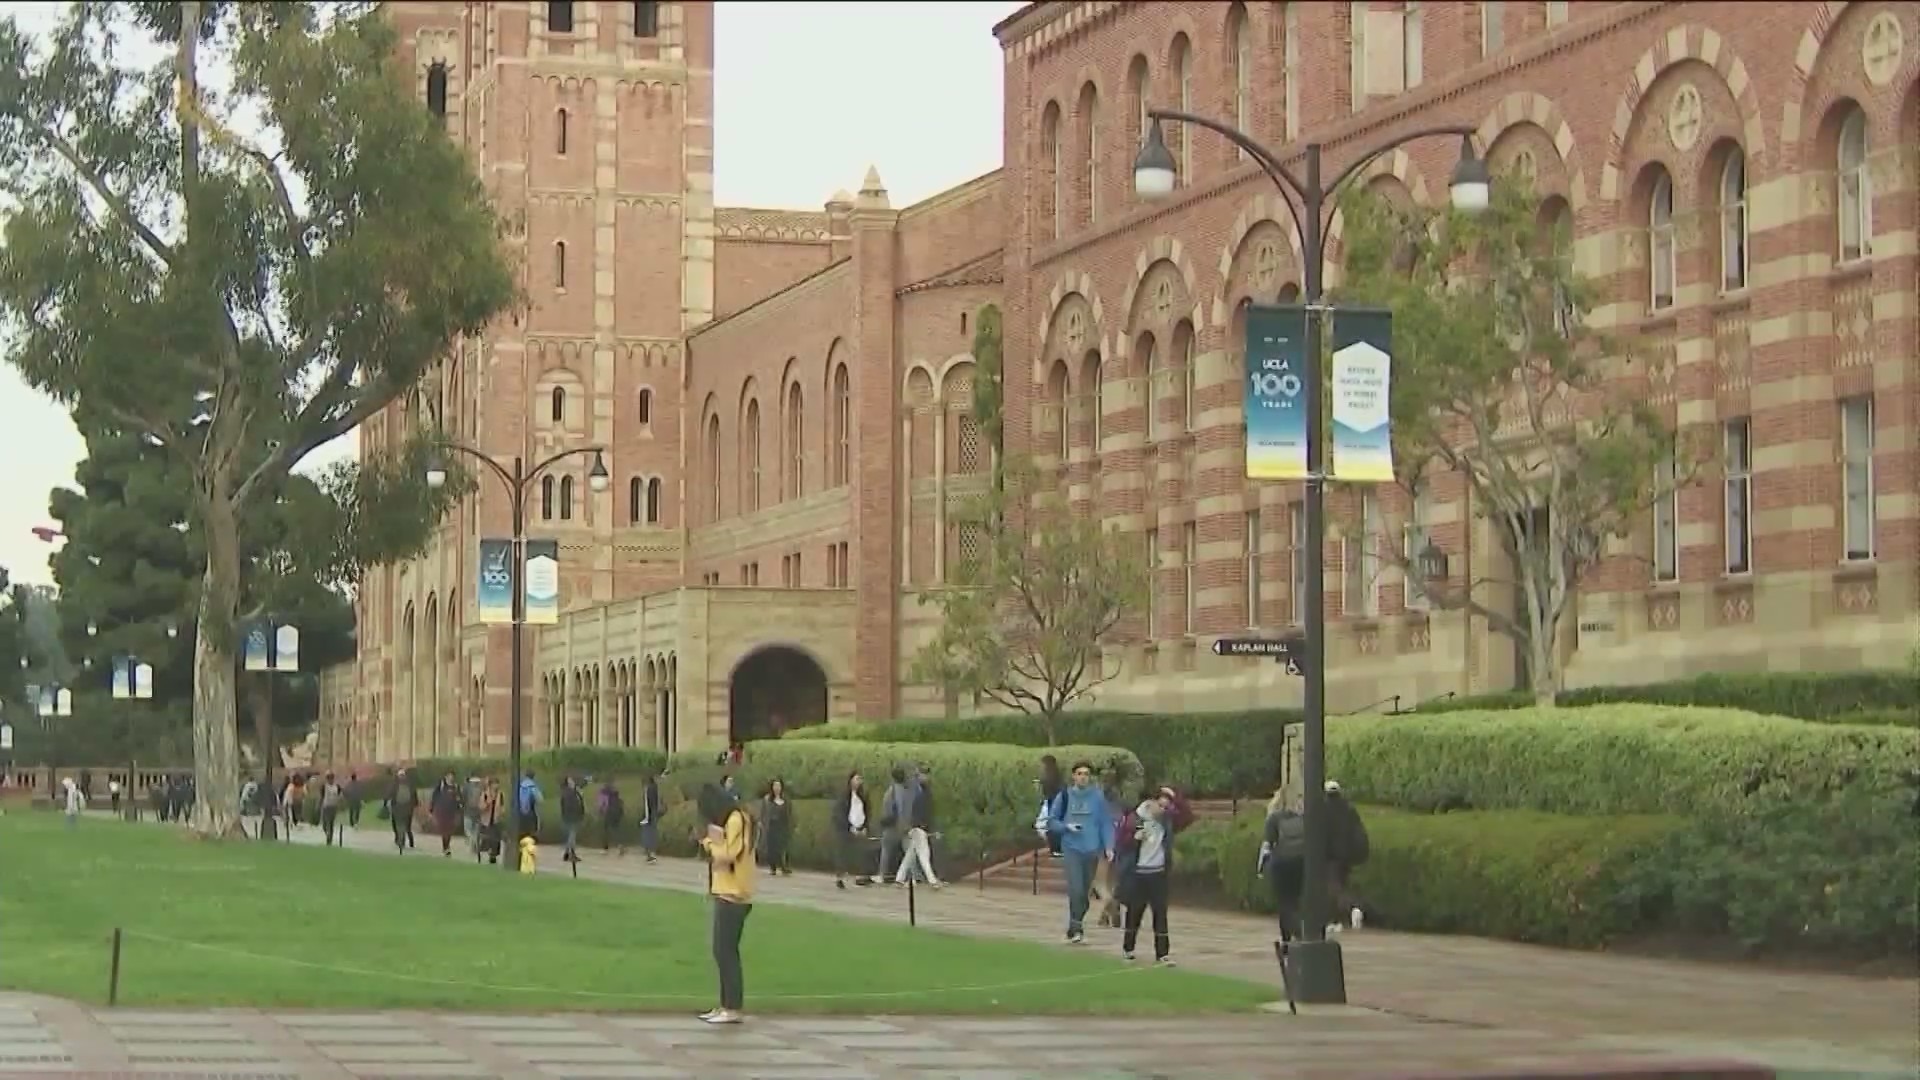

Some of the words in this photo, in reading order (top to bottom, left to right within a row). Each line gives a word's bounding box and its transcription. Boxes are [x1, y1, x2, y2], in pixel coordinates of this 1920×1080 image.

[1262, 359, 1289, 370] UCLA
[1250, 371, 1301, 398] 100
[483, 571, 509, 583] 100
[1231, 643, 1265, 652] KAPLAN
[1266, 643, 1288, 652] HALL
